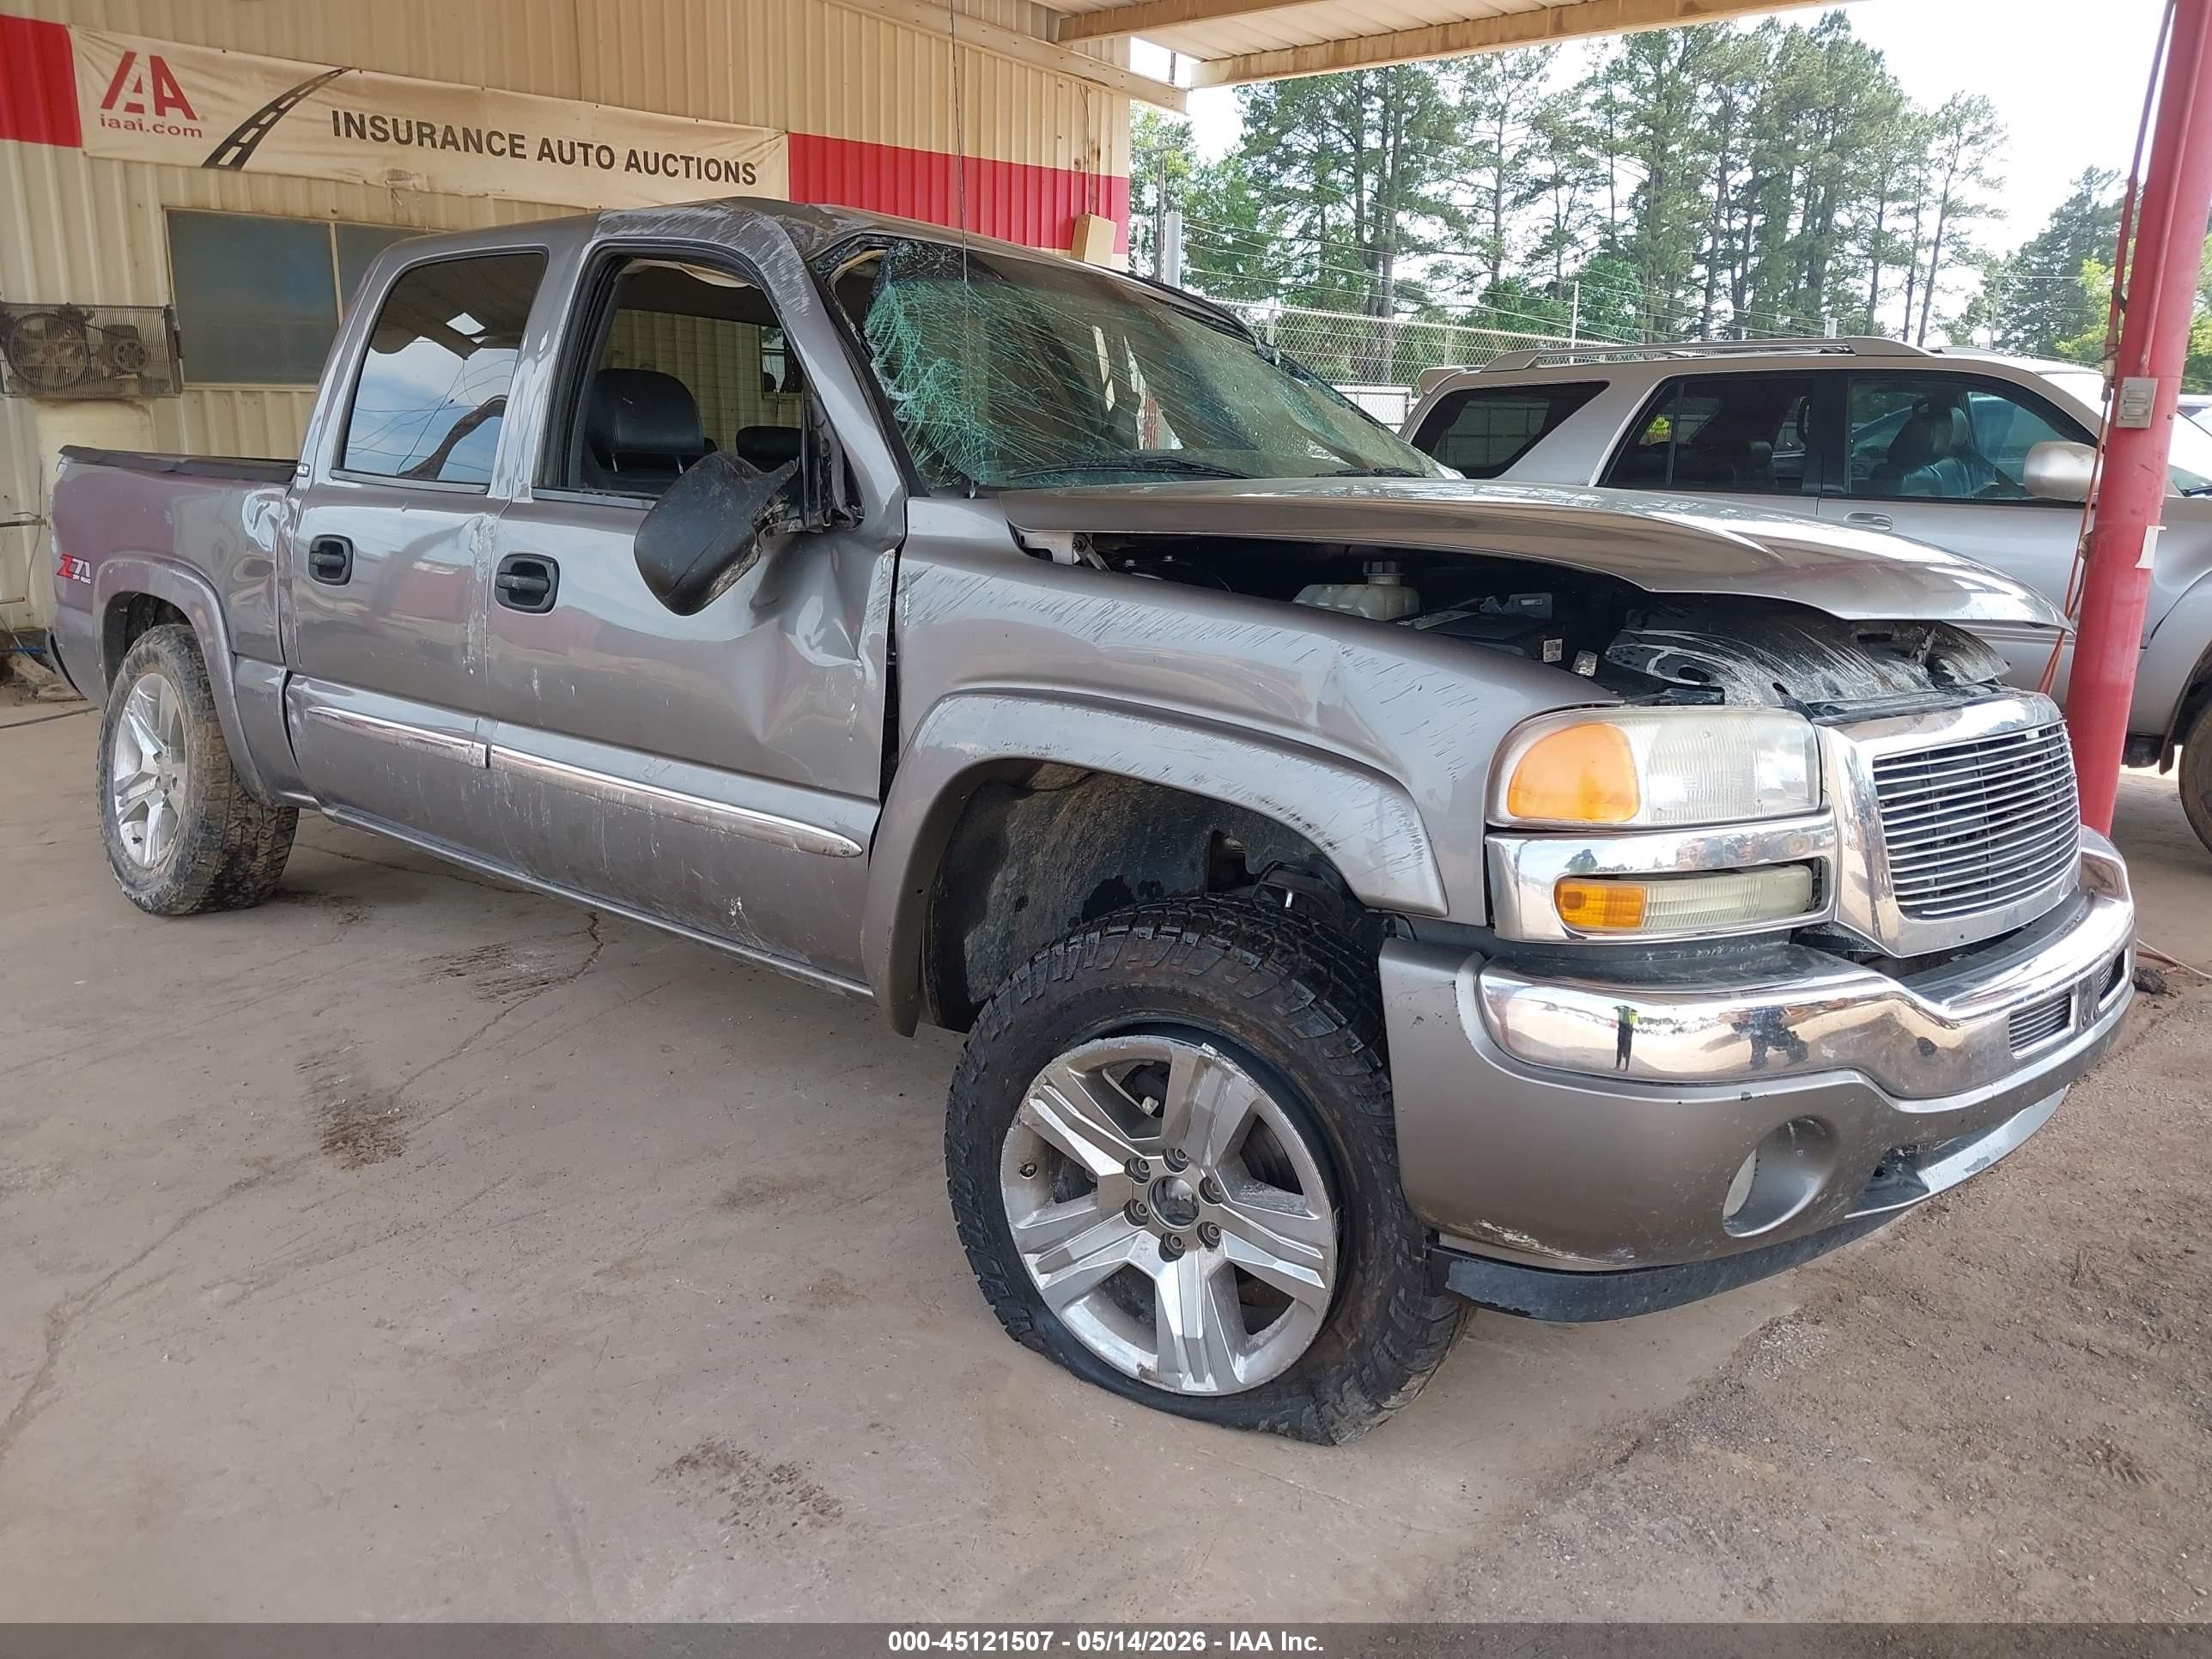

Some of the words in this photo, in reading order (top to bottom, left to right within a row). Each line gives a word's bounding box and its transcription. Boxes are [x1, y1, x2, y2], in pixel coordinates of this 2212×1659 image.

[100, 113, 203, 138] iaai.com
[331, 109, 527, 160] INSURANCE
[537, 137, 615, 170] AUTO
[624, 148, 757, 186] AUCTIONS
[57, 554, 90, 579] Z71
